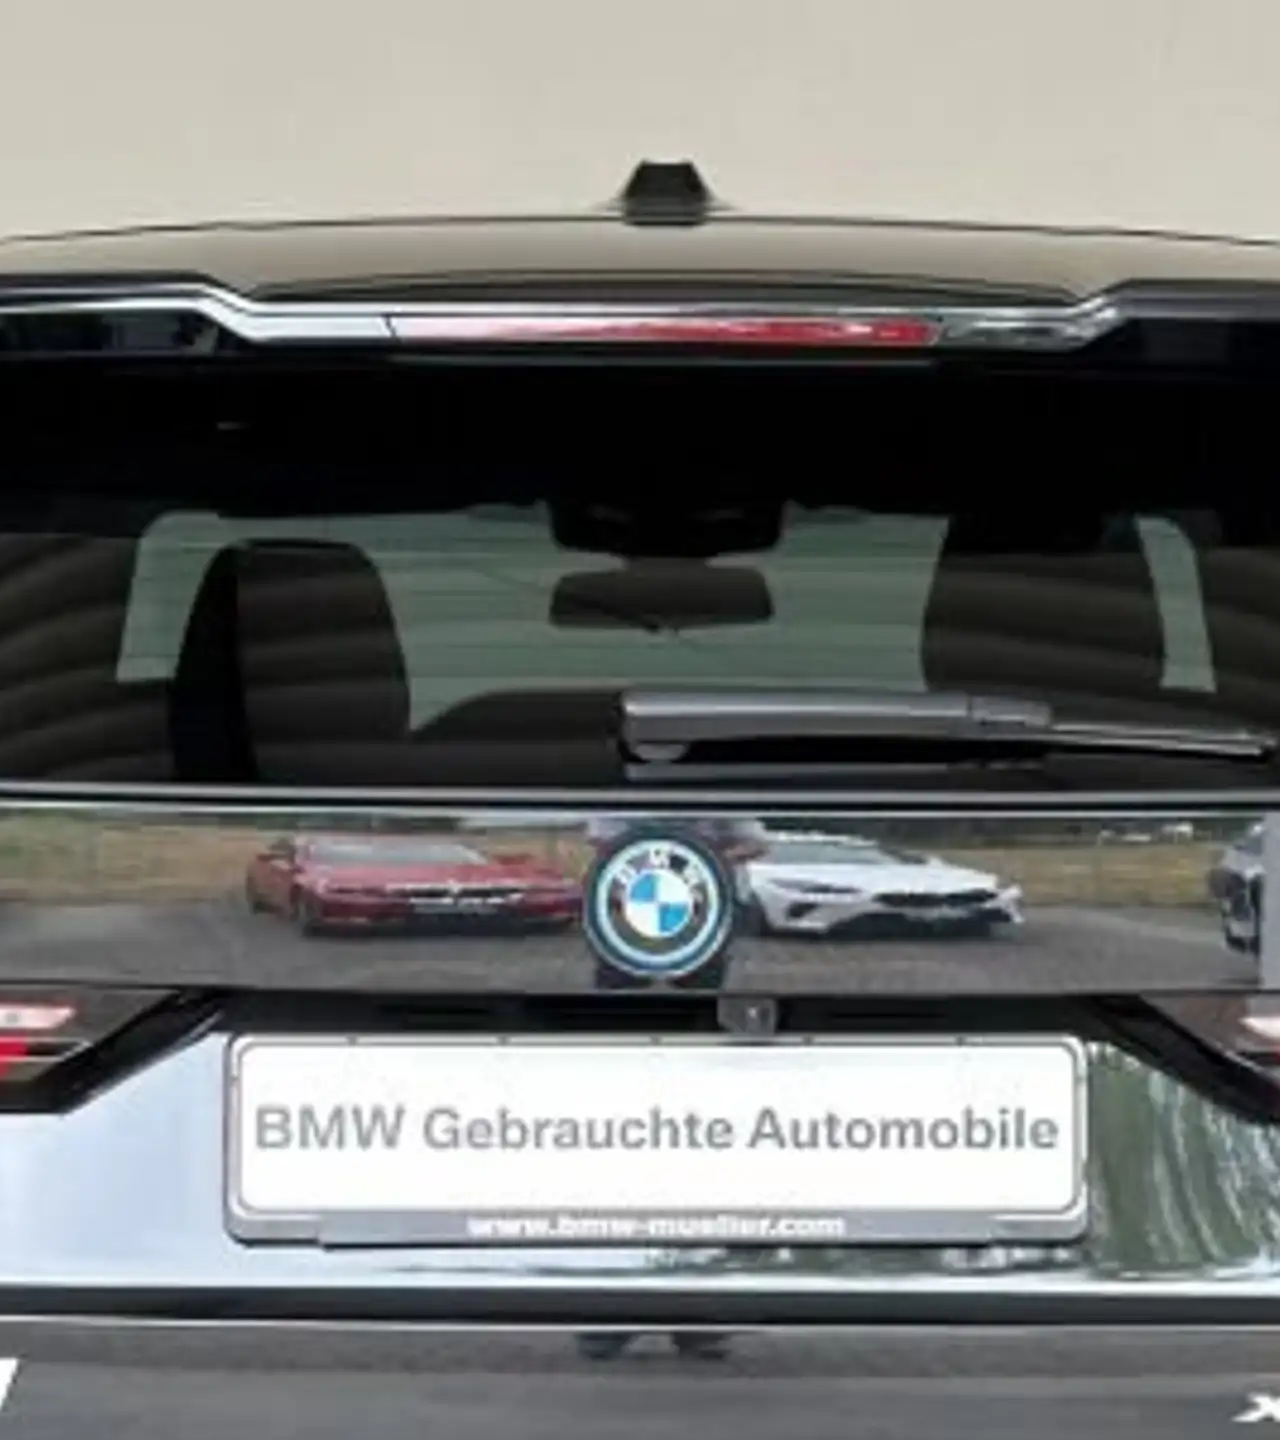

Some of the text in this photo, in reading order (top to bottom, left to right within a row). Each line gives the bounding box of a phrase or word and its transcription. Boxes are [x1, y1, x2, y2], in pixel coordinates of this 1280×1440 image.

[255, 1104, 1059, 1151] BMW Gebrauchte Automobile
